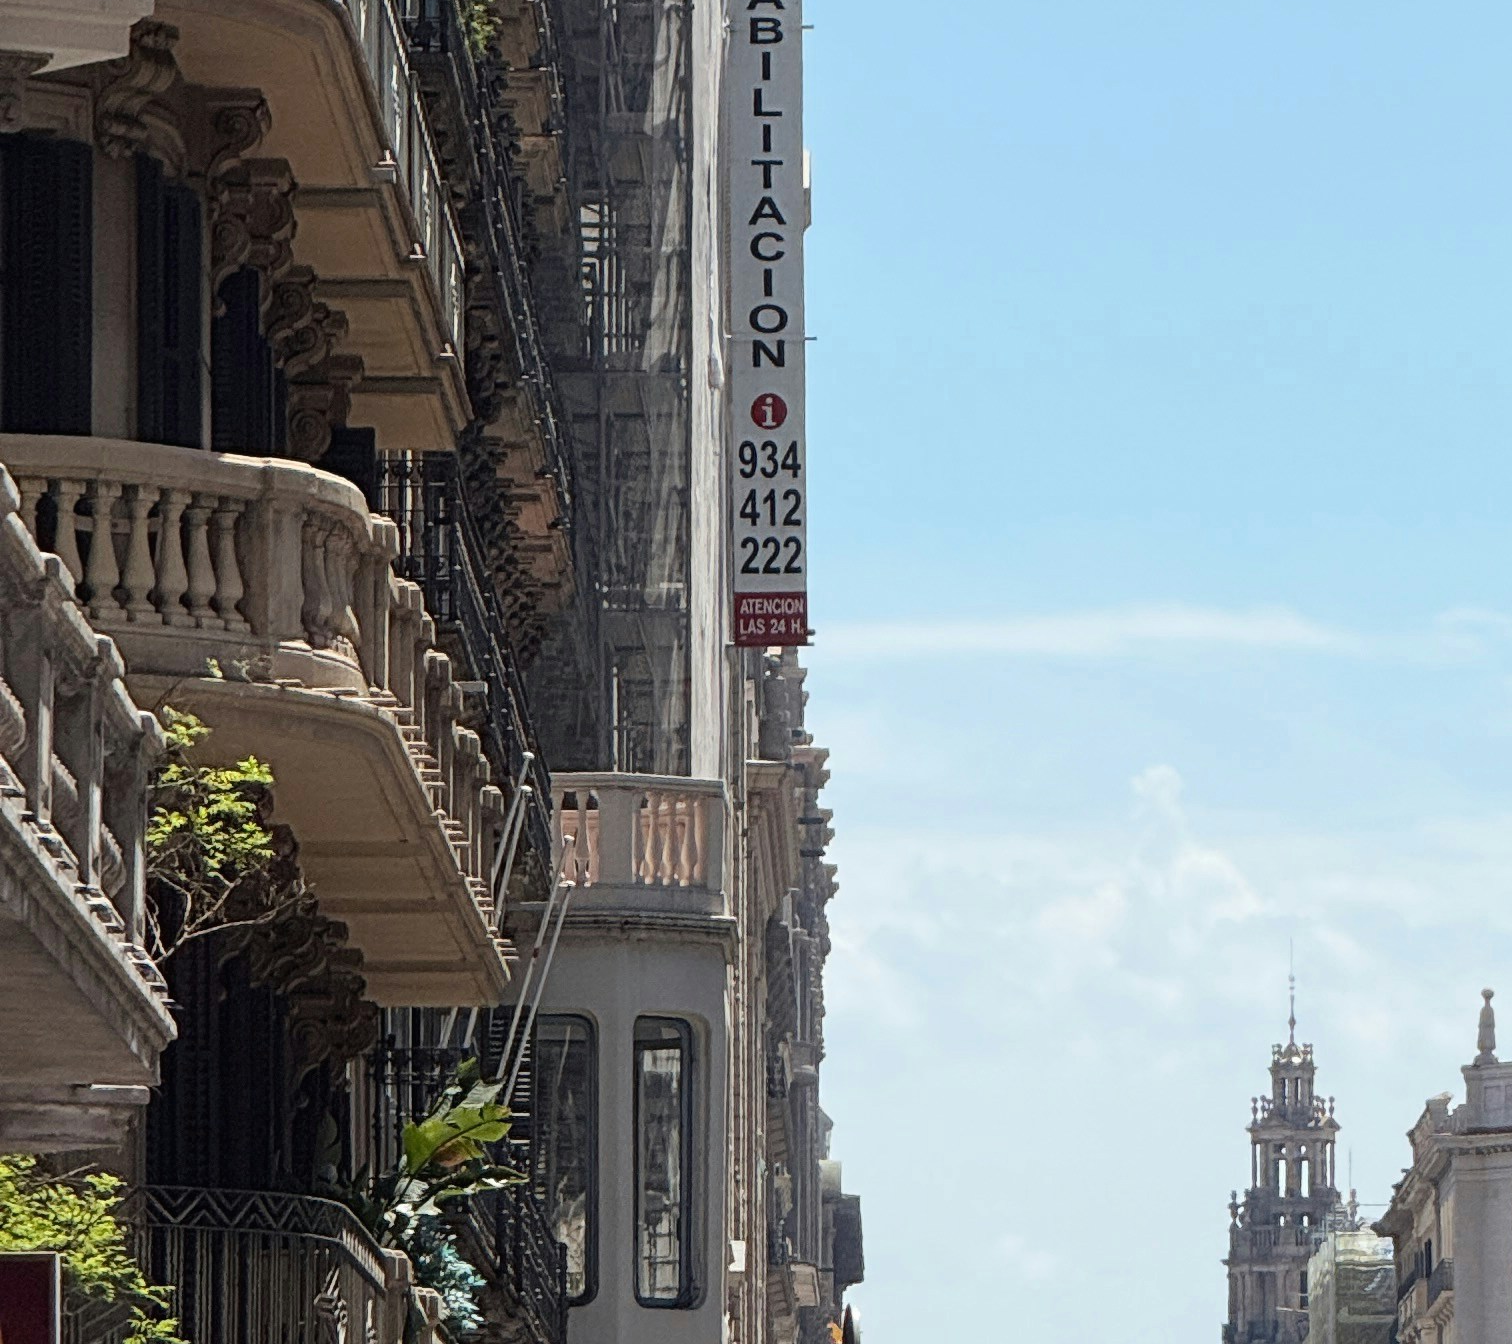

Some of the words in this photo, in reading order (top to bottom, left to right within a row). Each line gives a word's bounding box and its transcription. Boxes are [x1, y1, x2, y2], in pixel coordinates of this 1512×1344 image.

[738, 440, 801, 479] 934
[739, 488, 802, 527] 412
[740, 536, 802, 575] 222
[740, 598, 804, 614] ATENCION
[739, 618, 765, 634] LAS
[770, 618, 786, 634] 24
